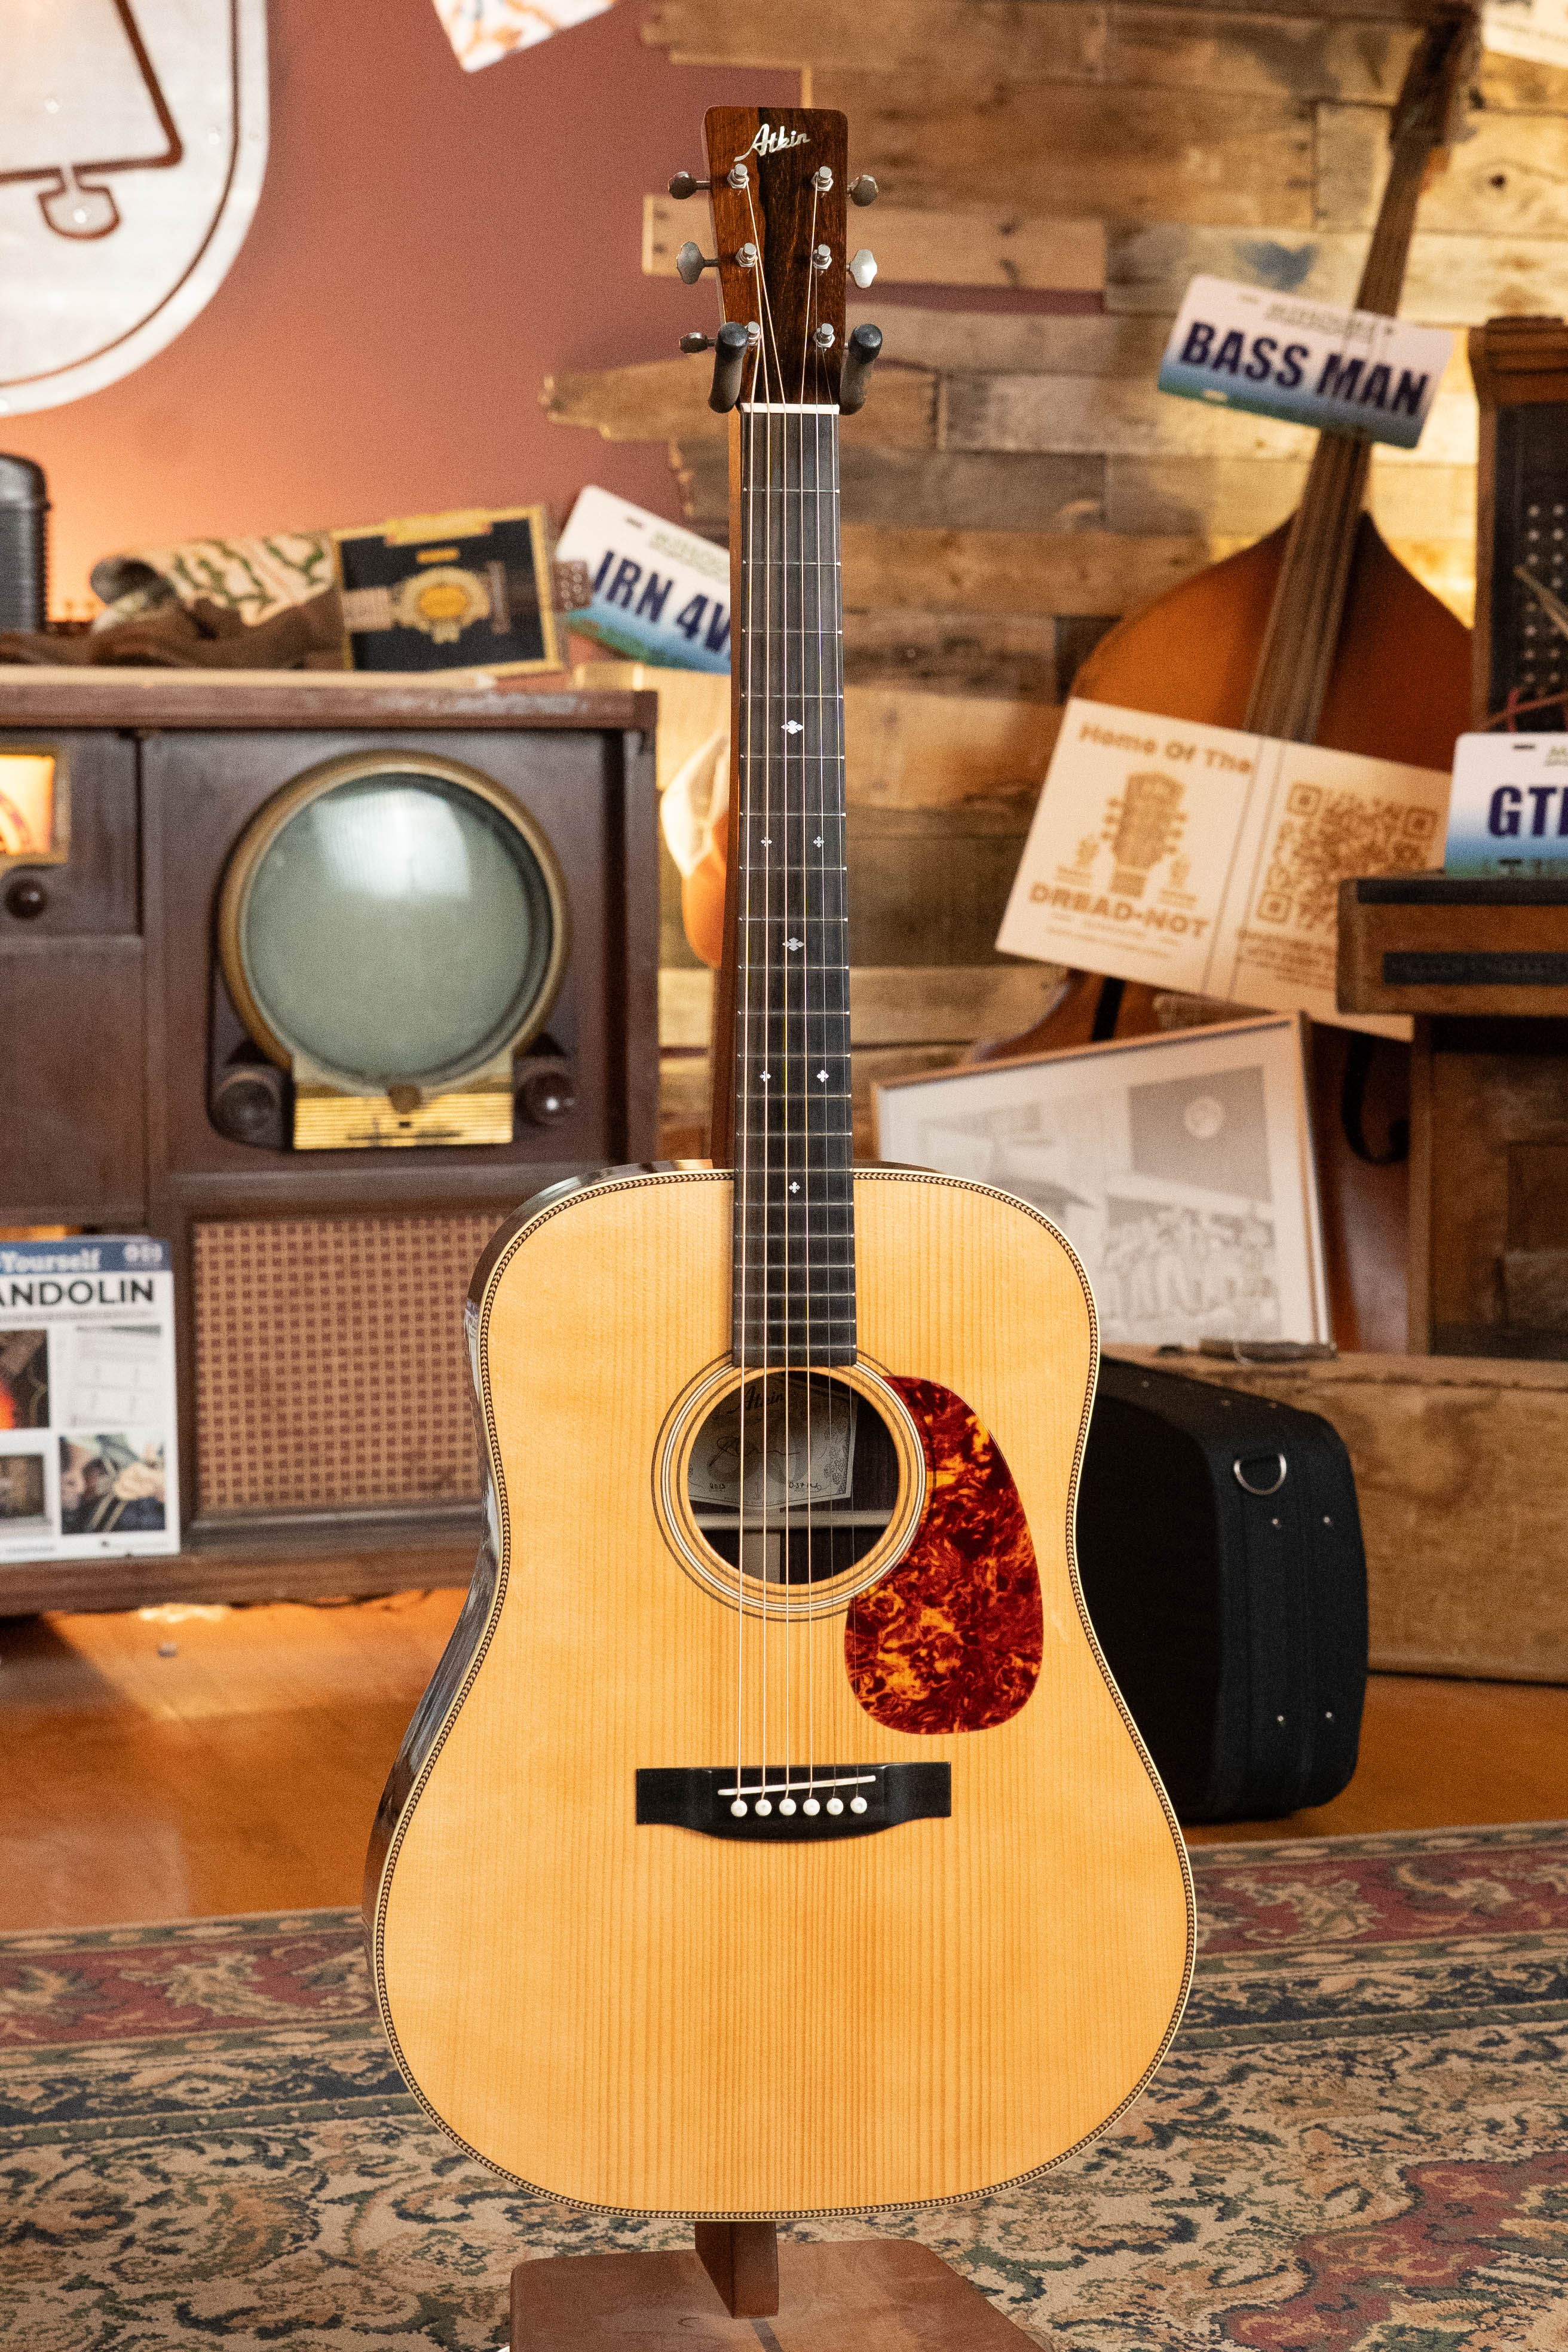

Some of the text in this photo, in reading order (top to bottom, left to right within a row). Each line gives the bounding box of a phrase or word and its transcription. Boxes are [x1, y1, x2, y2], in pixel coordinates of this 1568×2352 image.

[734, 123, 811, 161] Atkin
[1178, 321, 1310, 388] BASS
[1317, 353, 1429, 416] MAN
[593, 550, 674, 623] IRN
[1079, 722, 1252, 775] Home Of The
[1030, 883, 1209, 938] DREAD-NOT
[0, 1279, 154, 1307] NDOLIN
